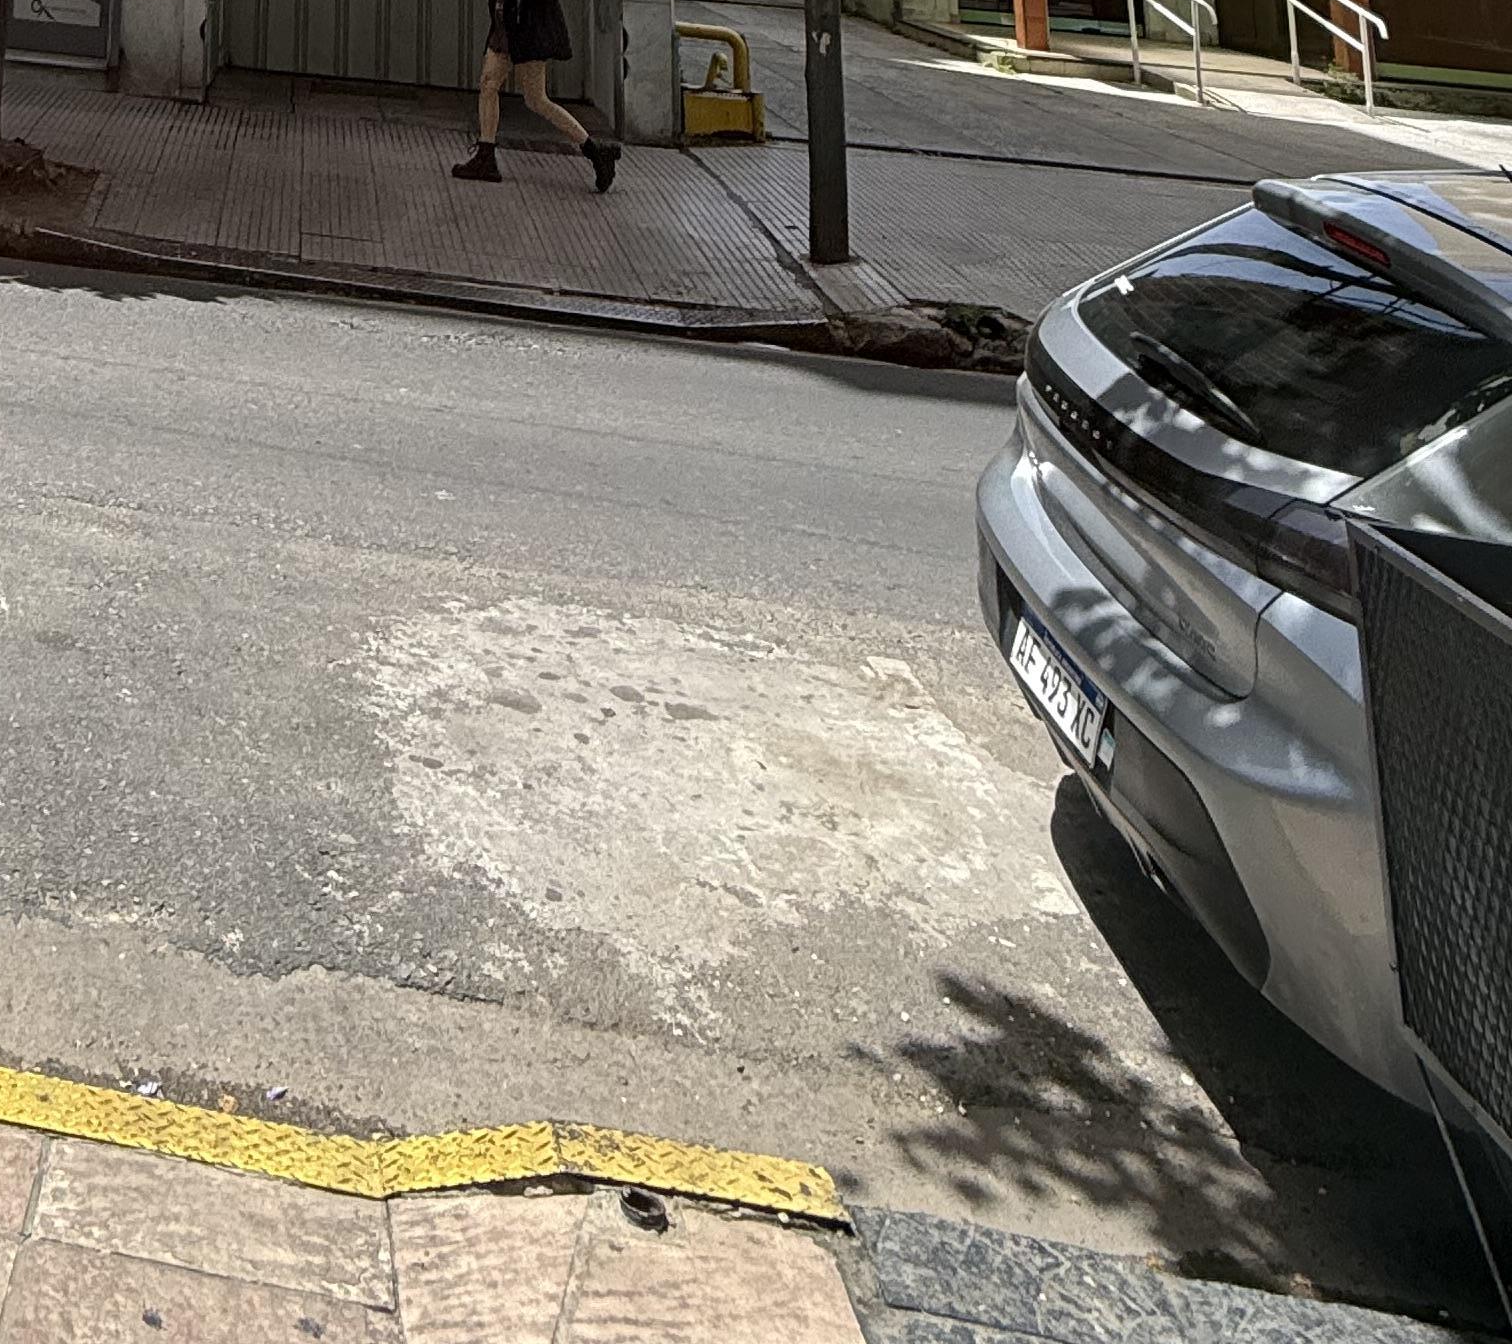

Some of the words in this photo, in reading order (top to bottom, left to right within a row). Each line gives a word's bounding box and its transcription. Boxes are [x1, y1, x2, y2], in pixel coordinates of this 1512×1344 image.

[1016, 628, 1041, 674] AF
[1040, 656, 1072, 719] 493
[1070, 694, 1095, 749] XC
